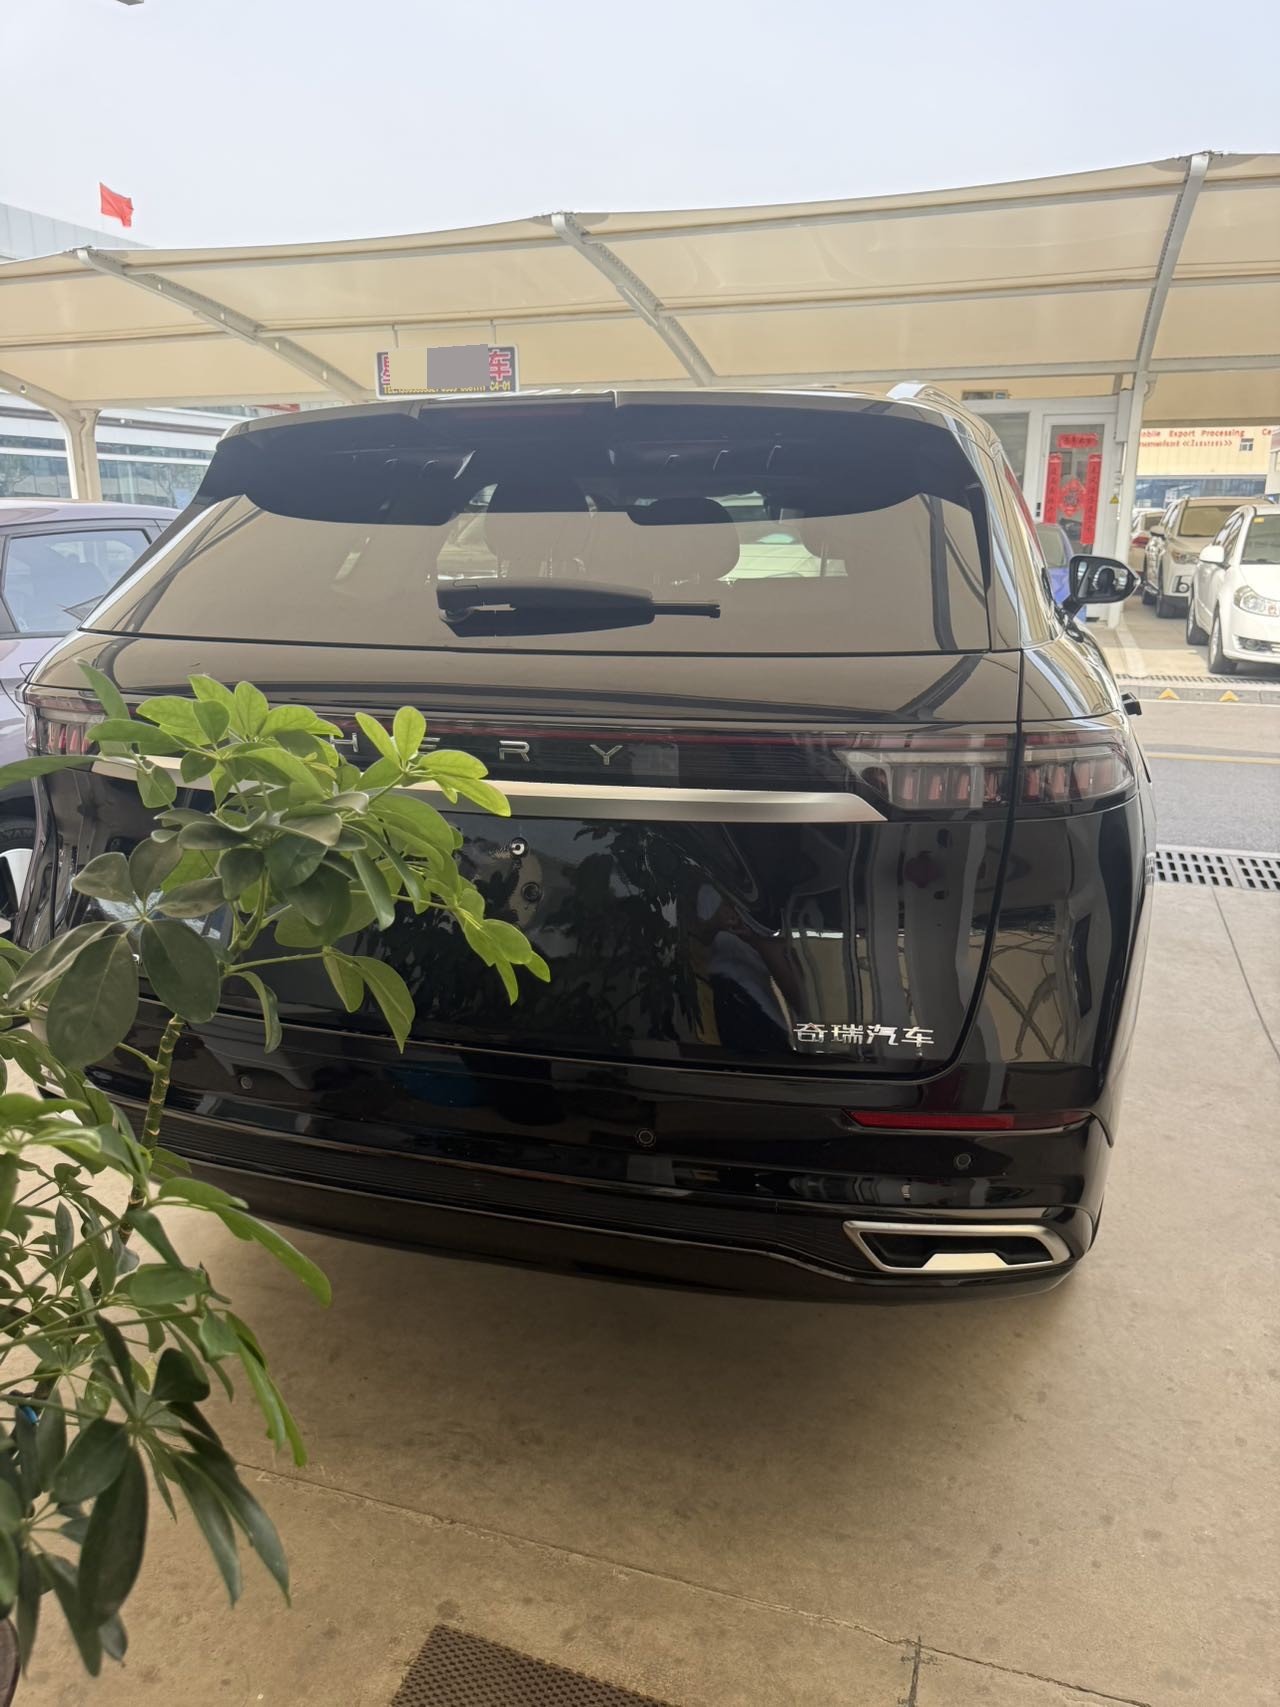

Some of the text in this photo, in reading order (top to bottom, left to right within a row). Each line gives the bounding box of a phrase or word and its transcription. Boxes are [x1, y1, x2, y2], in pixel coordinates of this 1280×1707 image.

[1169, 430, 1195, 438] Export
[1201, 428, 1245, 438] Processing
[1262, 428, 1272, 436] Ce
[792, 1022, 935, 1048] 奇瑞汽车
